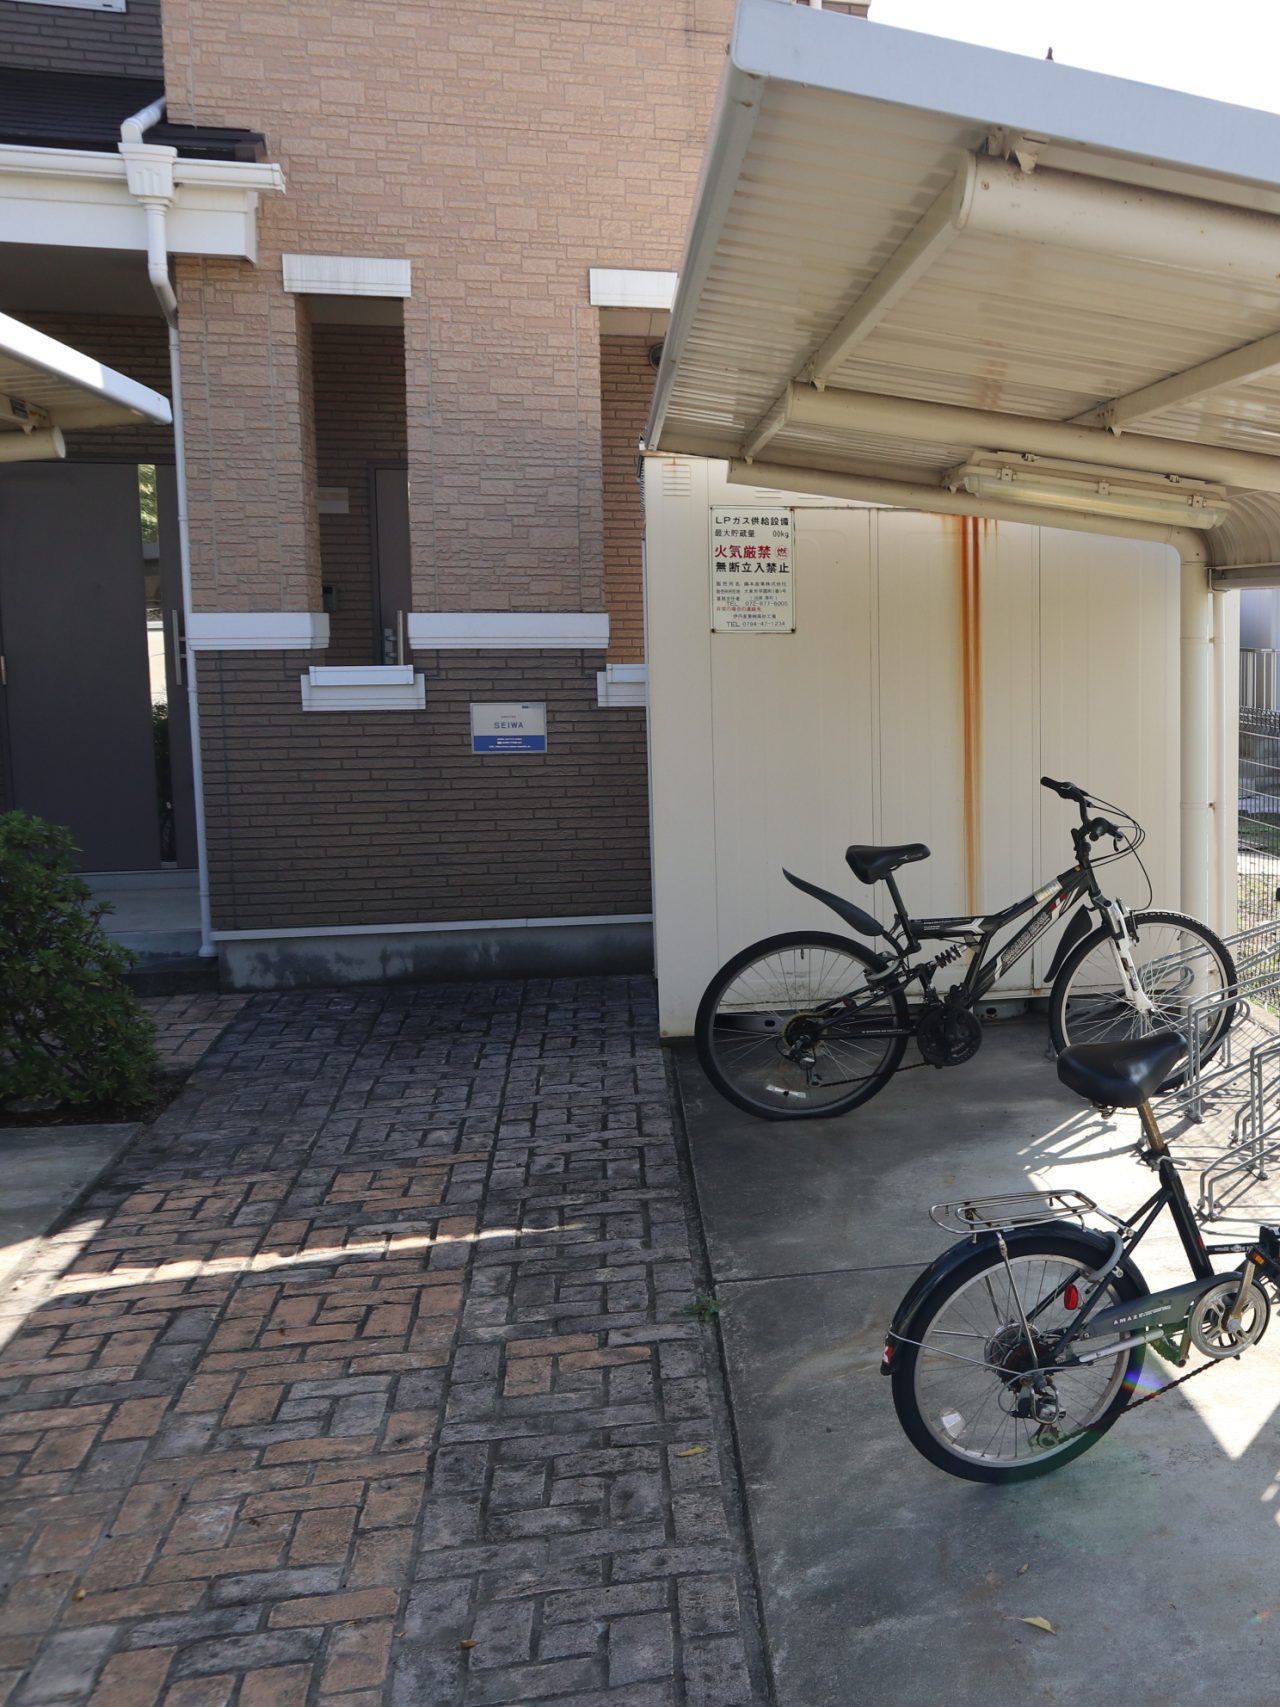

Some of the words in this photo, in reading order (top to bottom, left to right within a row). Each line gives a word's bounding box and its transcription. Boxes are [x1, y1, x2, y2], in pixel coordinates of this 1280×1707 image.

[715, 516, 789, 526] LPガス供給設備
[714, 529, 755, 538] 最大貯蔵量
[714, 544, 771, 559] 火気厳禁
[716, 561, 790, 573] 無断立入禁止
[494, 721, 524, 729] SEIWA
